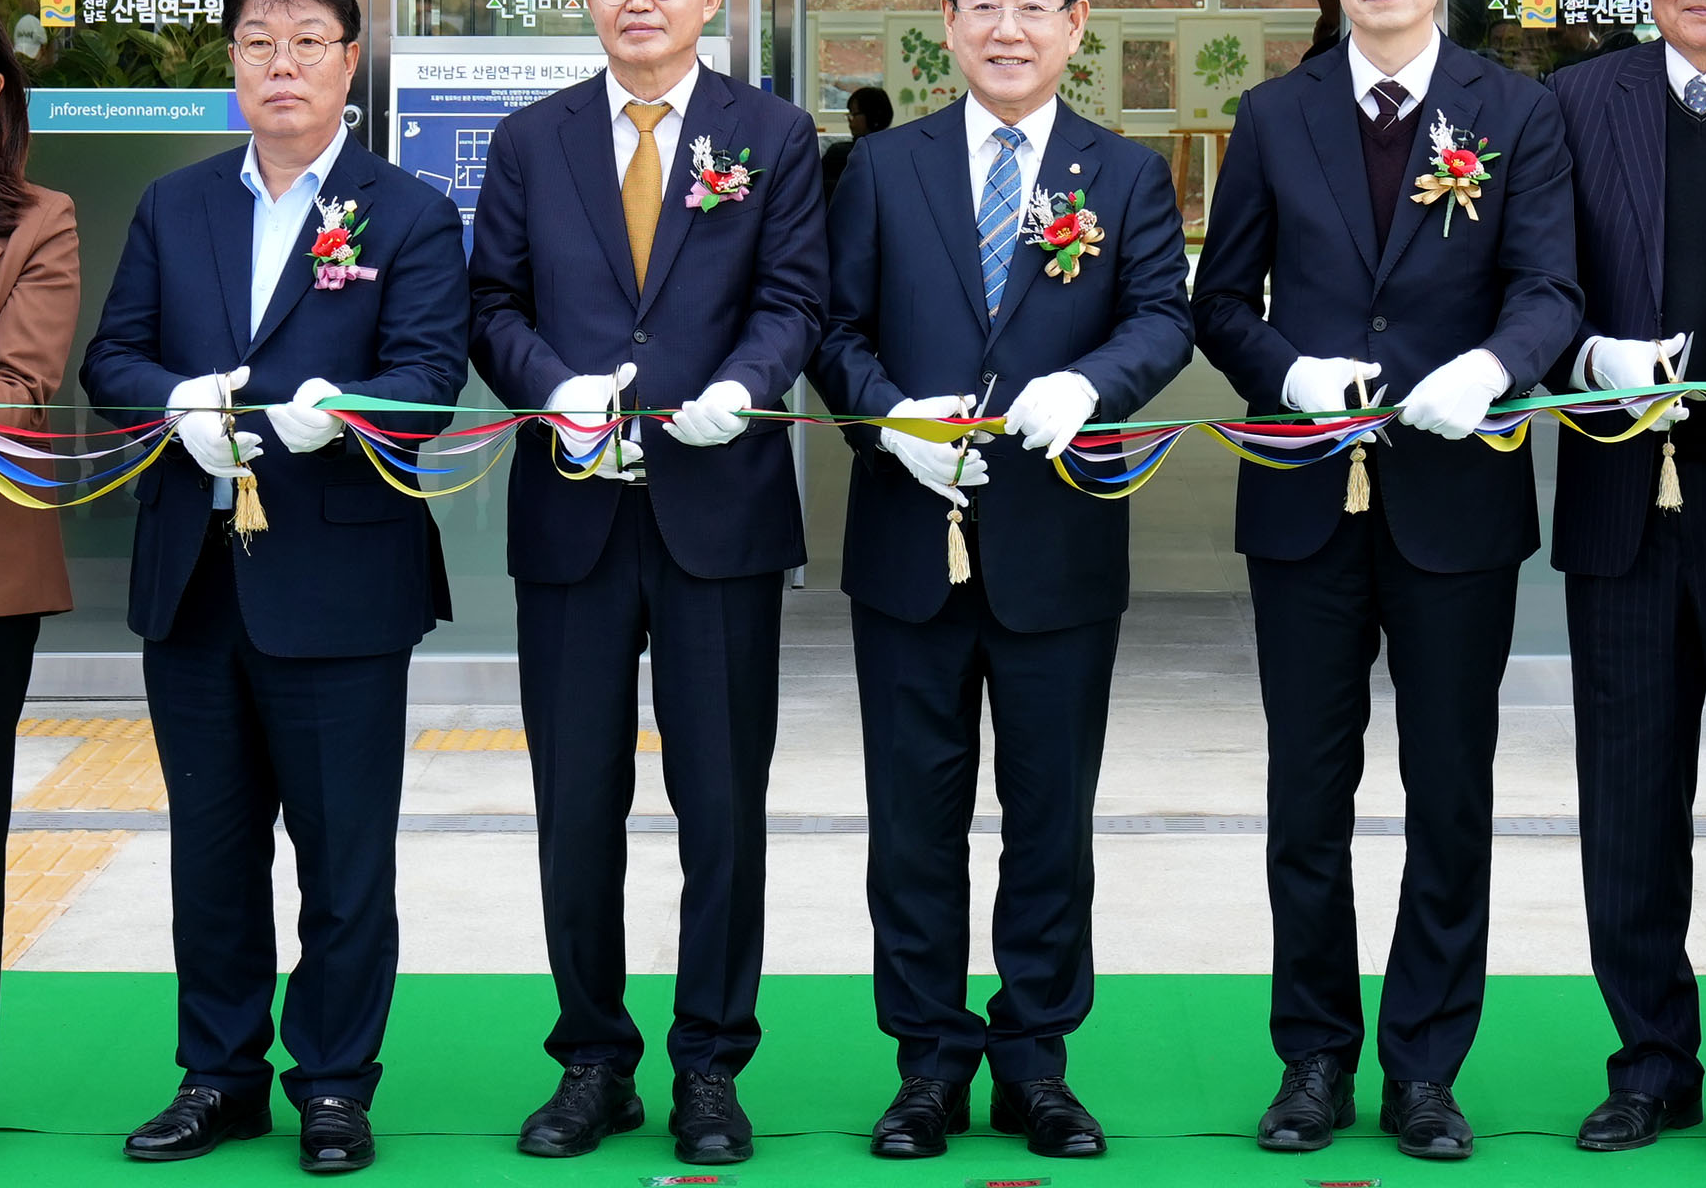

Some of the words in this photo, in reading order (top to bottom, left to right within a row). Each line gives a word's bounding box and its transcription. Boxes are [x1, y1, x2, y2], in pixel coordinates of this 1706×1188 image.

[82, 10, 108, 24] 남도
[417, 65, 467, 80] 전라남도
[472, 65, 536, 80] 산림연구원
[49, 102, 206, 119] jnforest.jeonnam.go.kr
